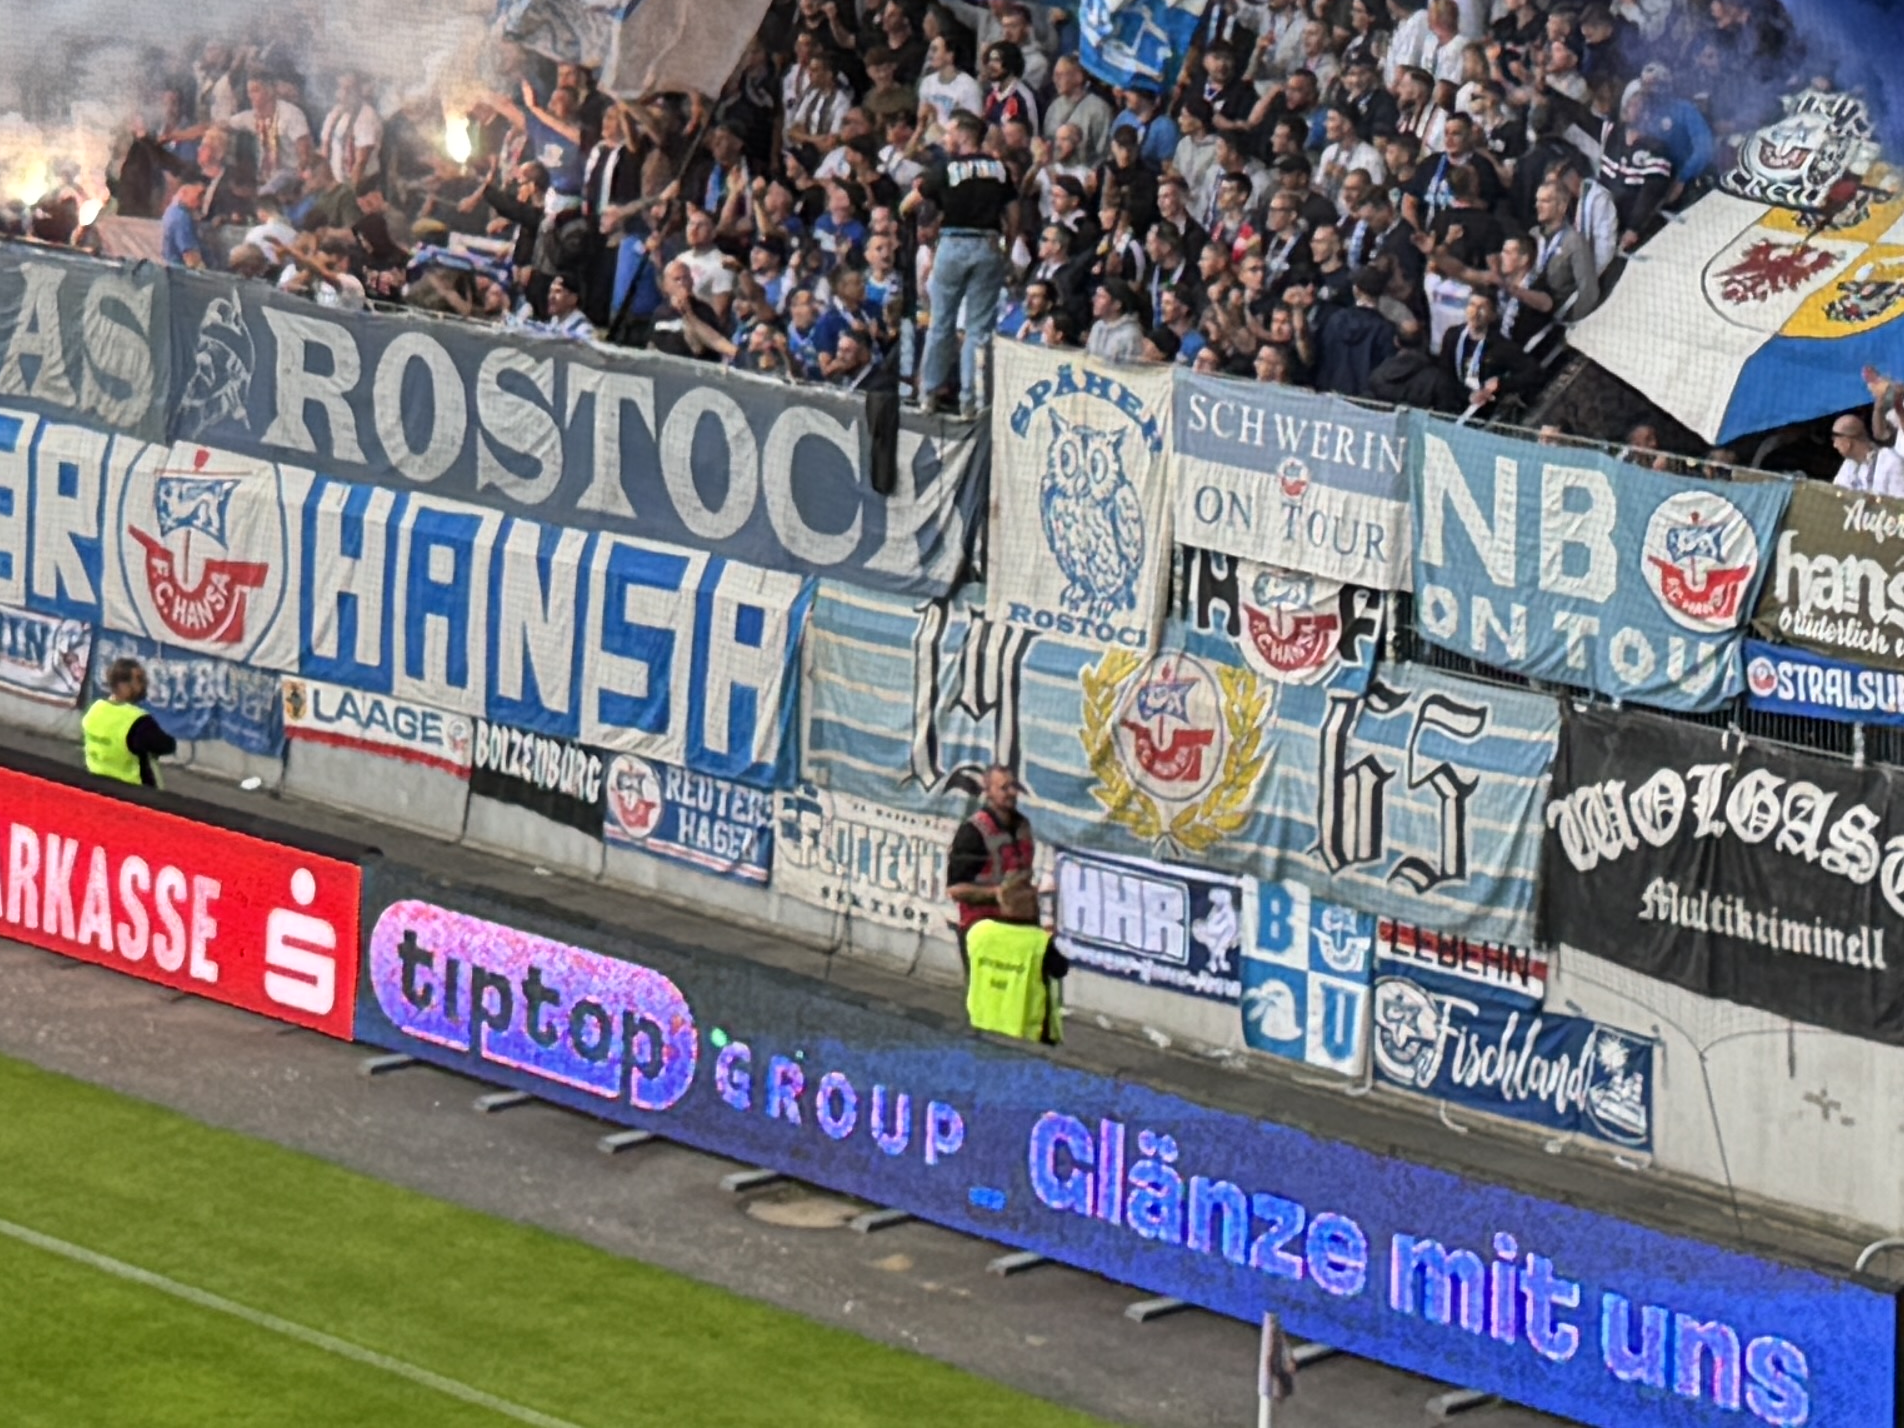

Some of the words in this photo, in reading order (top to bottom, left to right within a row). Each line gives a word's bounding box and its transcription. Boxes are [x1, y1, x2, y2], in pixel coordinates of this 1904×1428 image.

[261, 305, 981, 584] ROSTOCK
[1188, 394, 1408, 475] SCHWERIN
[1193, 485, 1253, 531] ON
[1281, 501, 1388, 564] TOUR
[1420, 432, 1618, 603] NB
[310, 484, 804, 769] HANSA
[1419, 583, 1528, 661] ON
[1552, 610, 1741, 696] TOU
[311, 688, 445, 746] LAAGE
[1637, 875, 1888, 970] Multikriminell
[1415, 991, 1597, 1115] Fischland
[397, 929, 668, 1106] tiptop
[714, 1041, 965, 1166] GROUP
[1028, 1110, 1369, 1297] Glänze
[1390, 1231, 1581, 1363] mit
[1600, 1292, 1811, 1428] uns
